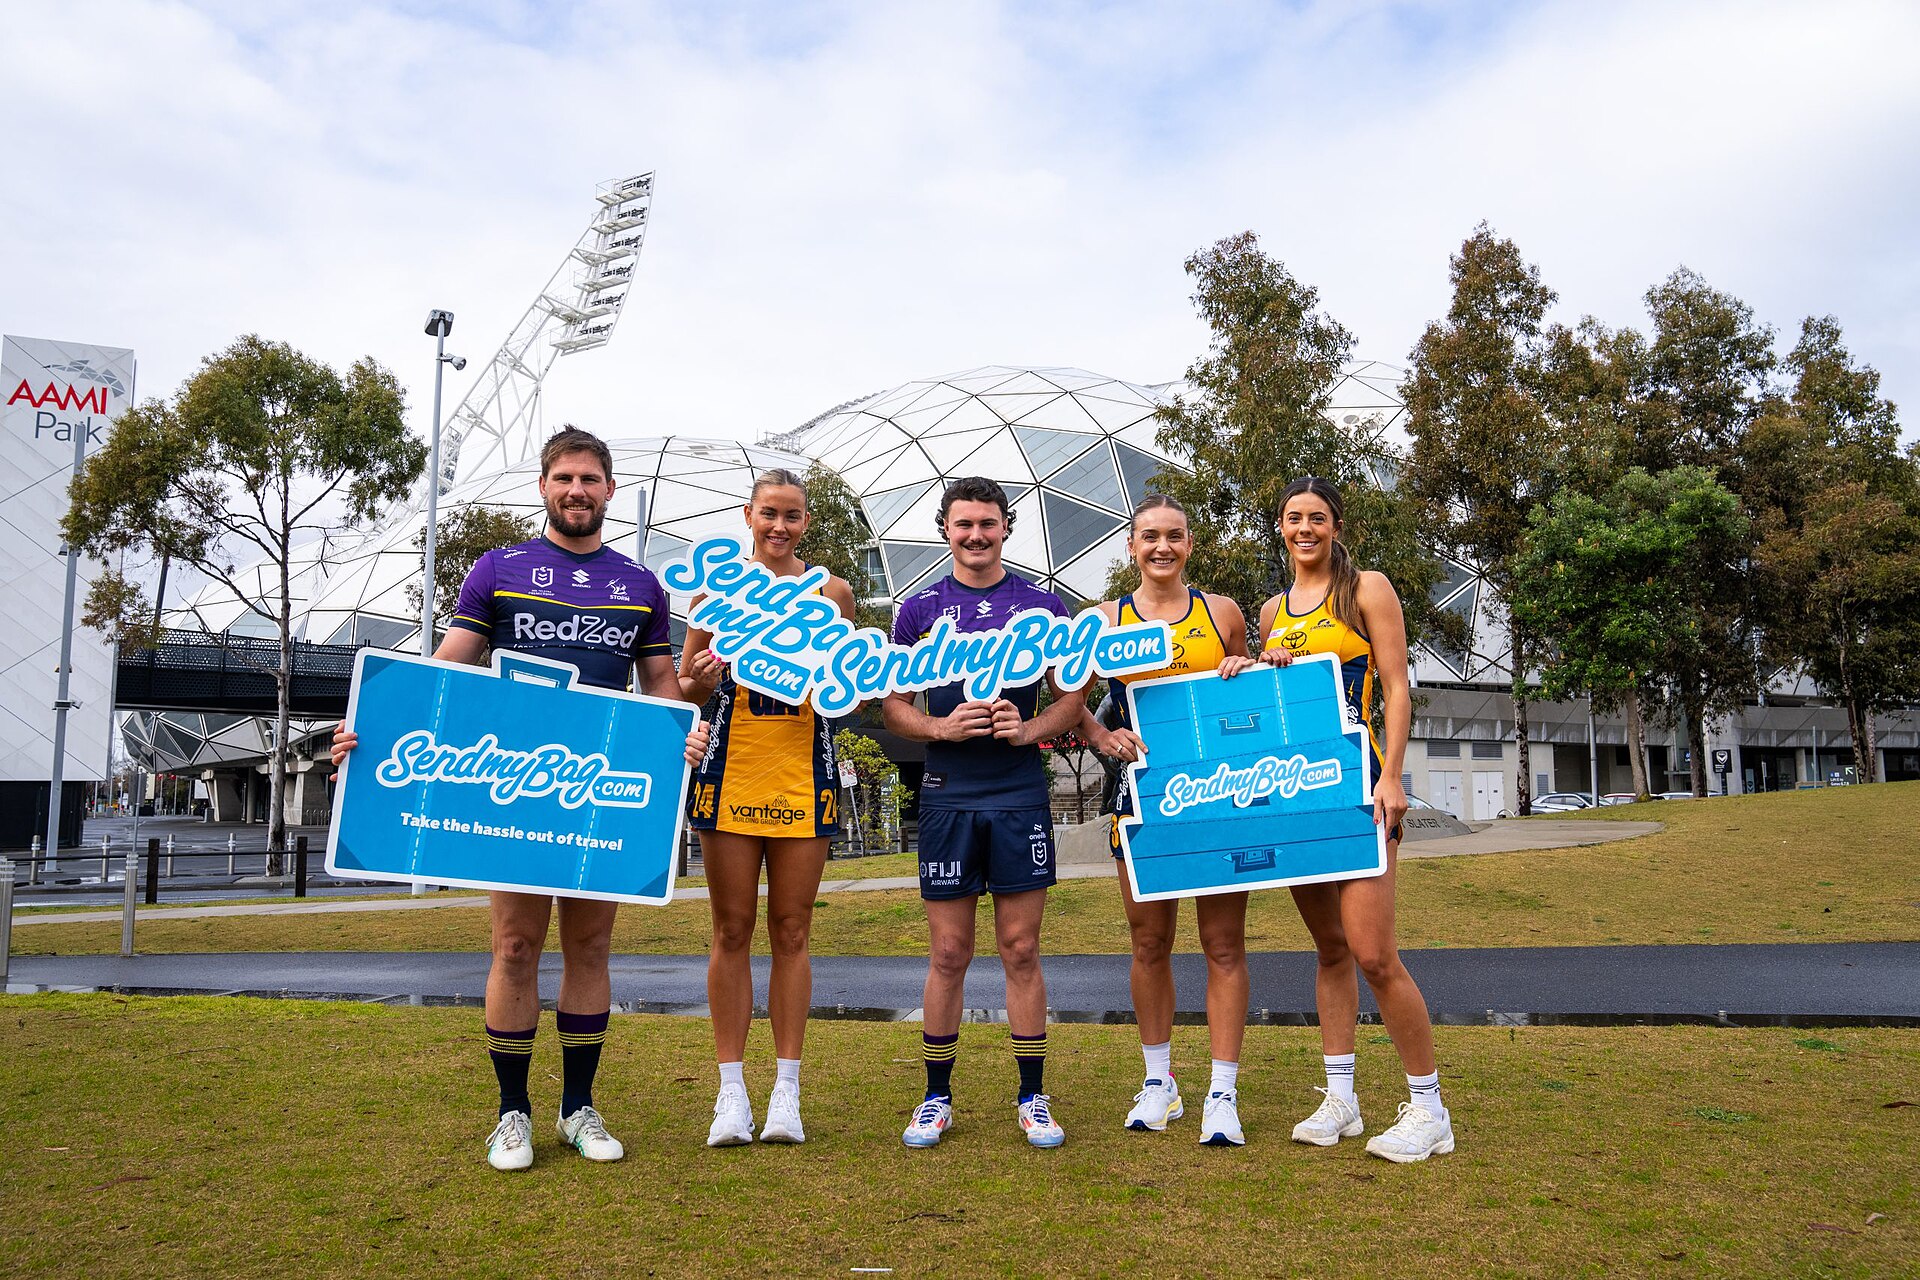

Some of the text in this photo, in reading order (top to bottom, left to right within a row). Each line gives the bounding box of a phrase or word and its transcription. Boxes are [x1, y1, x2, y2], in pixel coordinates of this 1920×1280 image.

[6, 378, 108, 415] AAMI
[663, 537, 824, 616] Send
[609, 594, 630, 602] STORM
[514, 612, 639, 649] RedZed
[819, 612, 1161, 711] SendmyBag.com
[1289, 650, 1312, 658] YOTA
[380, 734, 643, 805] SendmyBag.com
[1163, 757, 1337, 813] SendmyBag.com
[729, 804, 806, 825] vantage
[732, 816, 781, 826] BUILDING GROUP
[1406, 818, 1441, 829] SLATER
[400, 812, 623, 851] Take the hassle out of travel
[928, 861, 962, 878] FIJI
[931, 878, 960, 886] AIRWAYS
